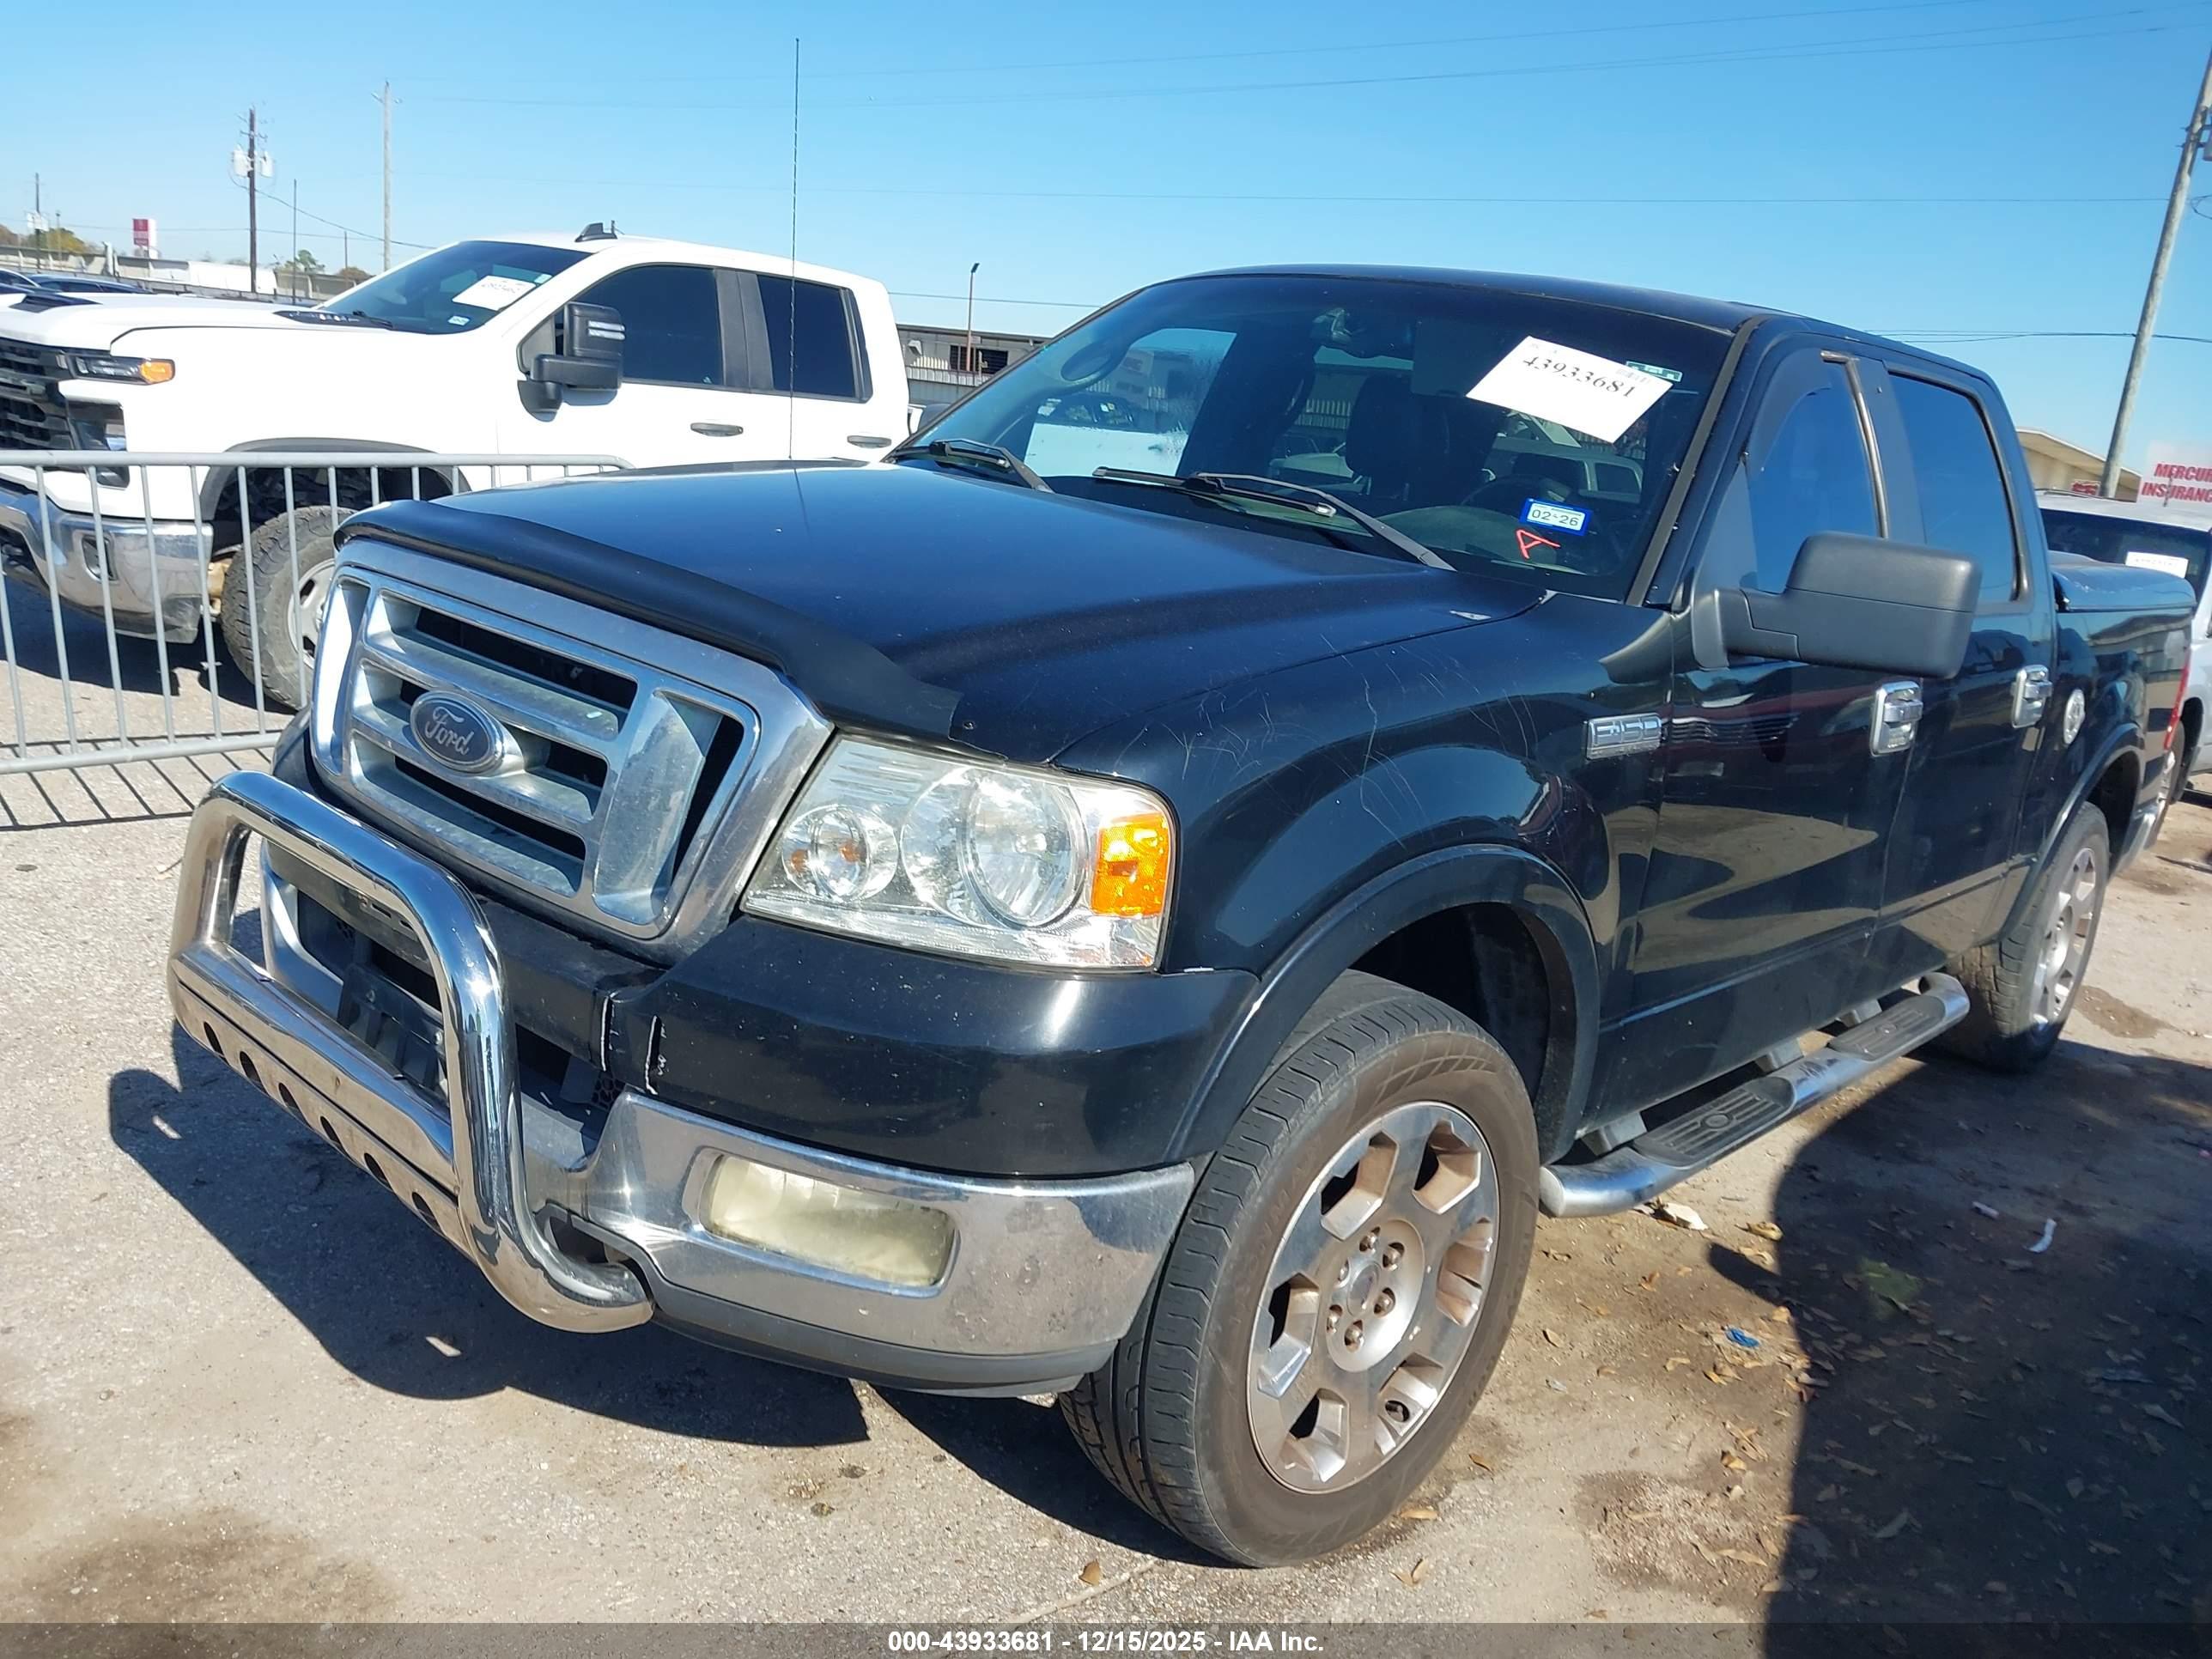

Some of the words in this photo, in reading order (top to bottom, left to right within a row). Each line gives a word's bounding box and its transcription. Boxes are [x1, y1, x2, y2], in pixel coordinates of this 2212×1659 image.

[1522, 356, 1635, 398] 43933681
[1532, 509, 1580, 526] 02-26
[1516, 529, 1561, 559] A
[425, 706, 475, 756] Ford
